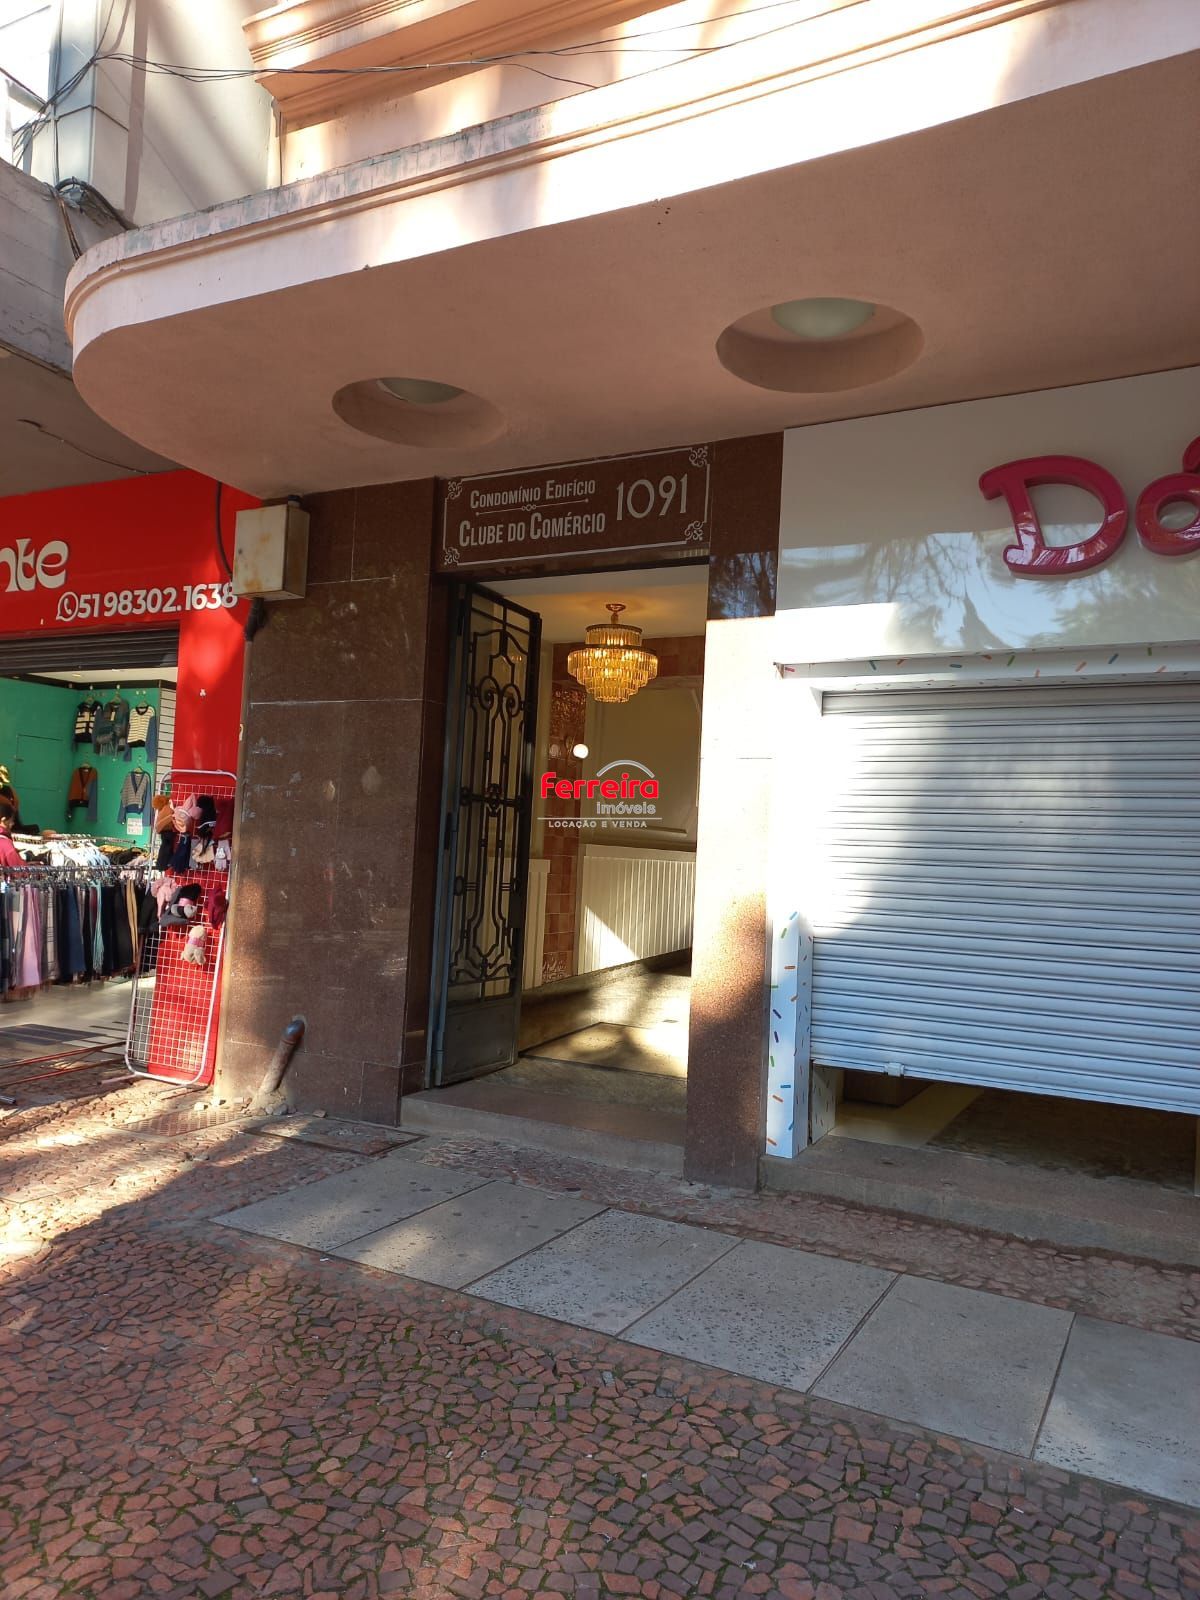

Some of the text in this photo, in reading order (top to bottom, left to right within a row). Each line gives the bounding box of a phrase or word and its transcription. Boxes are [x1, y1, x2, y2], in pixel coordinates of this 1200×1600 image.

[470, 479, 596, 509] CONDOMÍNIO EDIFÍCIO
[616, 473, 688, 521] 1091
[459, 512, 606, 547] CLUBE DO COMÉRCIO
[104, 582, 238, 617] 98302.1638
